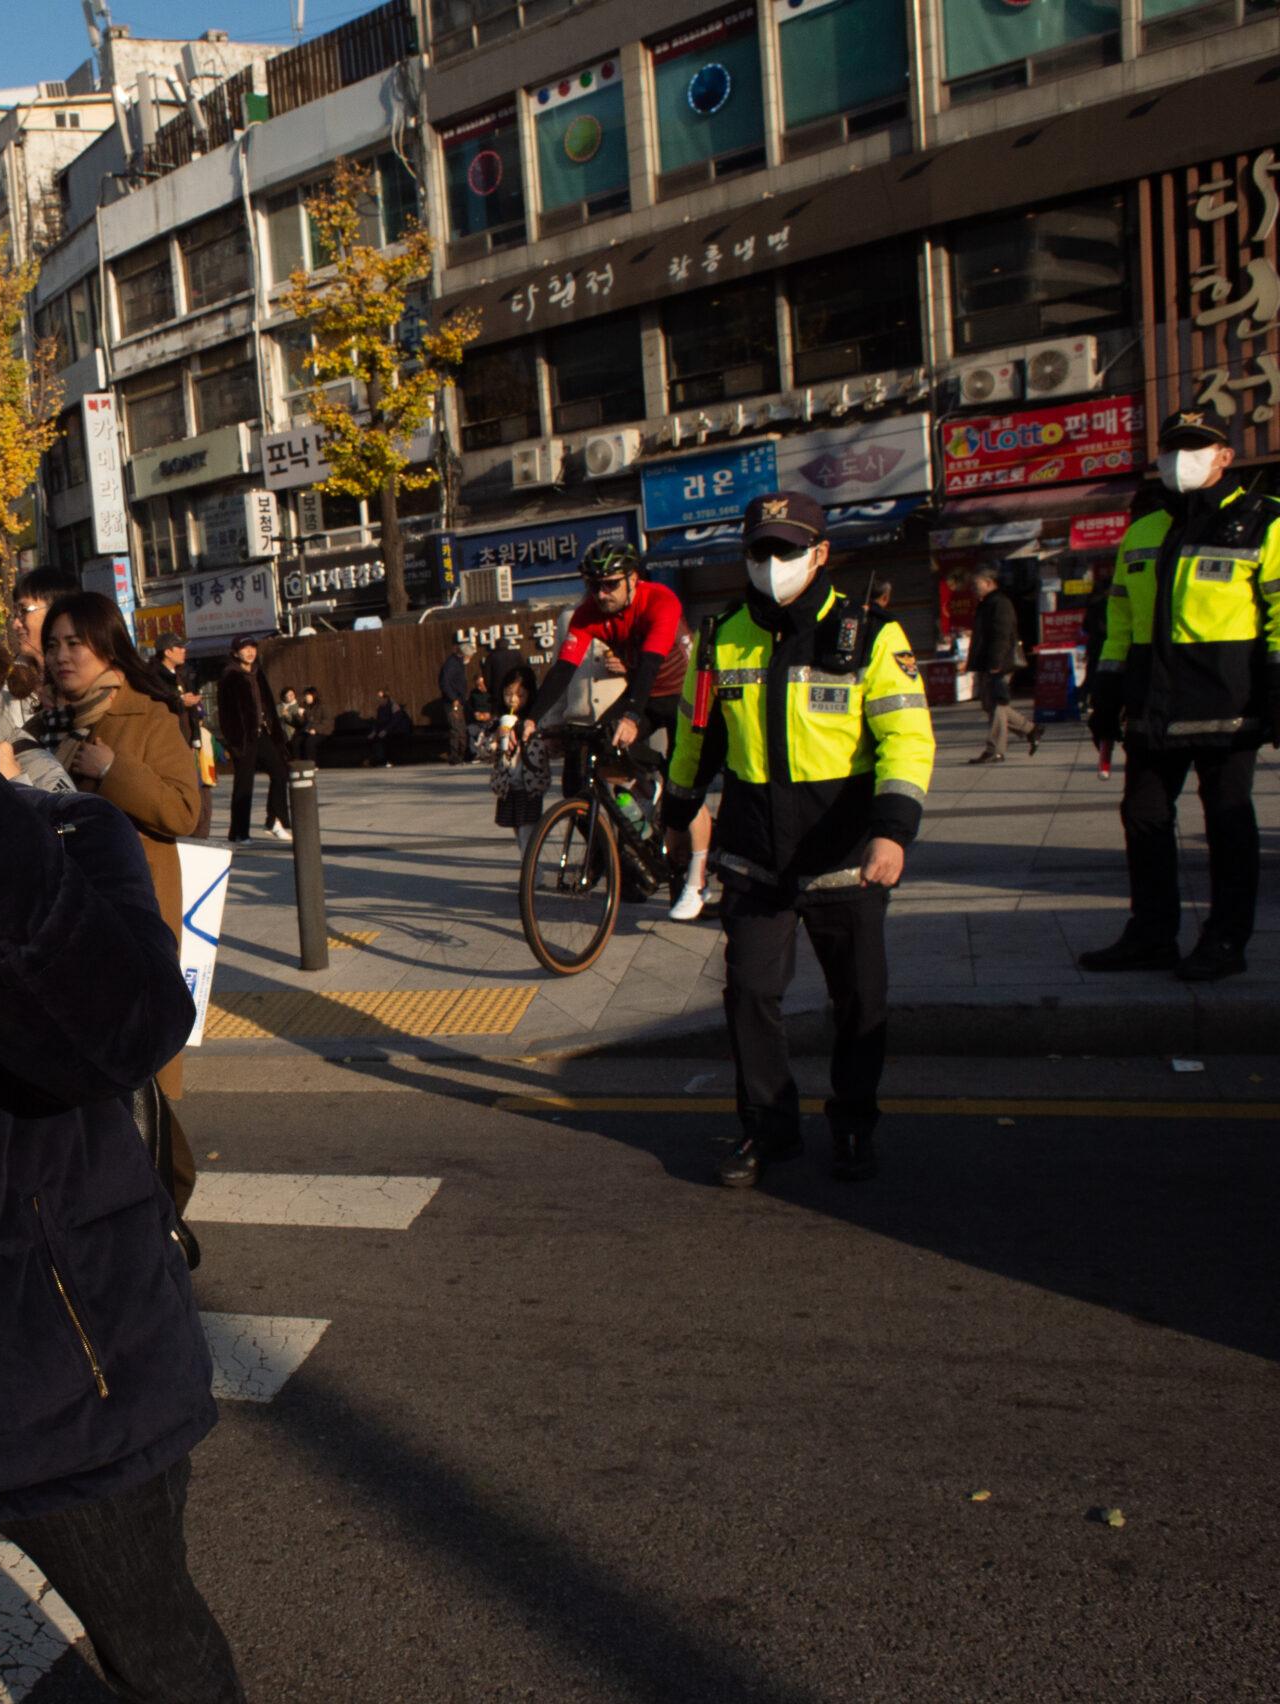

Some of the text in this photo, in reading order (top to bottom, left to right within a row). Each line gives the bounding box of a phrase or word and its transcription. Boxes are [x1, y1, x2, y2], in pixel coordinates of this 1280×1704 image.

[983, 422, 1064, 453] Lotto
[1064, 404, 1145, 440] 판매점
[93, 417, 119, 501] 카메라
[159, 450, 208, 477] SONY
[267, 436, 310, 476] 포낙
[683, 469, 735, 500] 라온
[948, 466, 1026, 491] 스포츠토토
[258, 496, 274, 551] 보청기
[441, 544, 455, 584] 카메라
[479, 533, 579, 568] 초원카메라
[189, 572, 268, 608] 방송장비
[811, 703, 846, 712] POLICE
